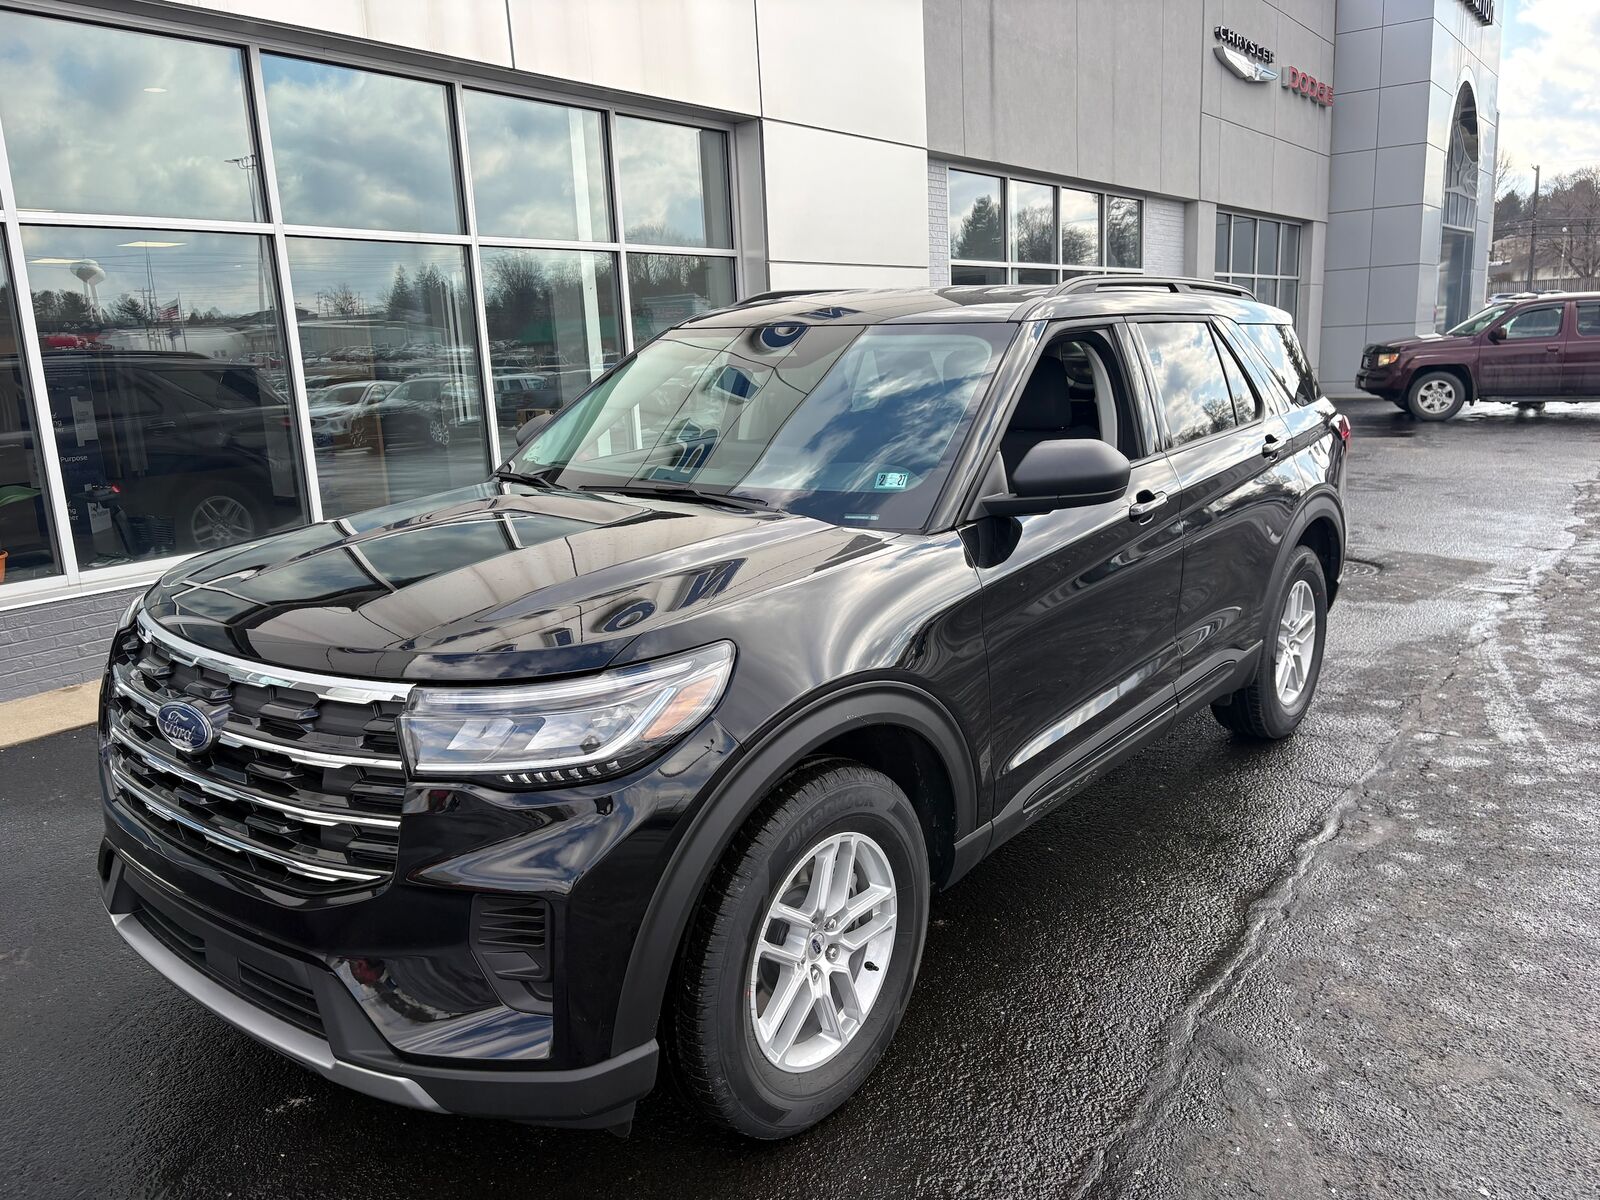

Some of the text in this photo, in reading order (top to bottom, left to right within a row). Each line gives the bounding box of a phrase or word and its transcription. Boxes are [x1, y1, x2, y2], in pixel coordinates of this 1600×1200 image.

[1215, 25, 1275, 64] CHRYSLER
[1287, 66, 1334, 106] DODGE
[60, 455, 88, 463] Purpose
[897, 474, 906, 486] 27
[164, 711, 195, 742] Ford
